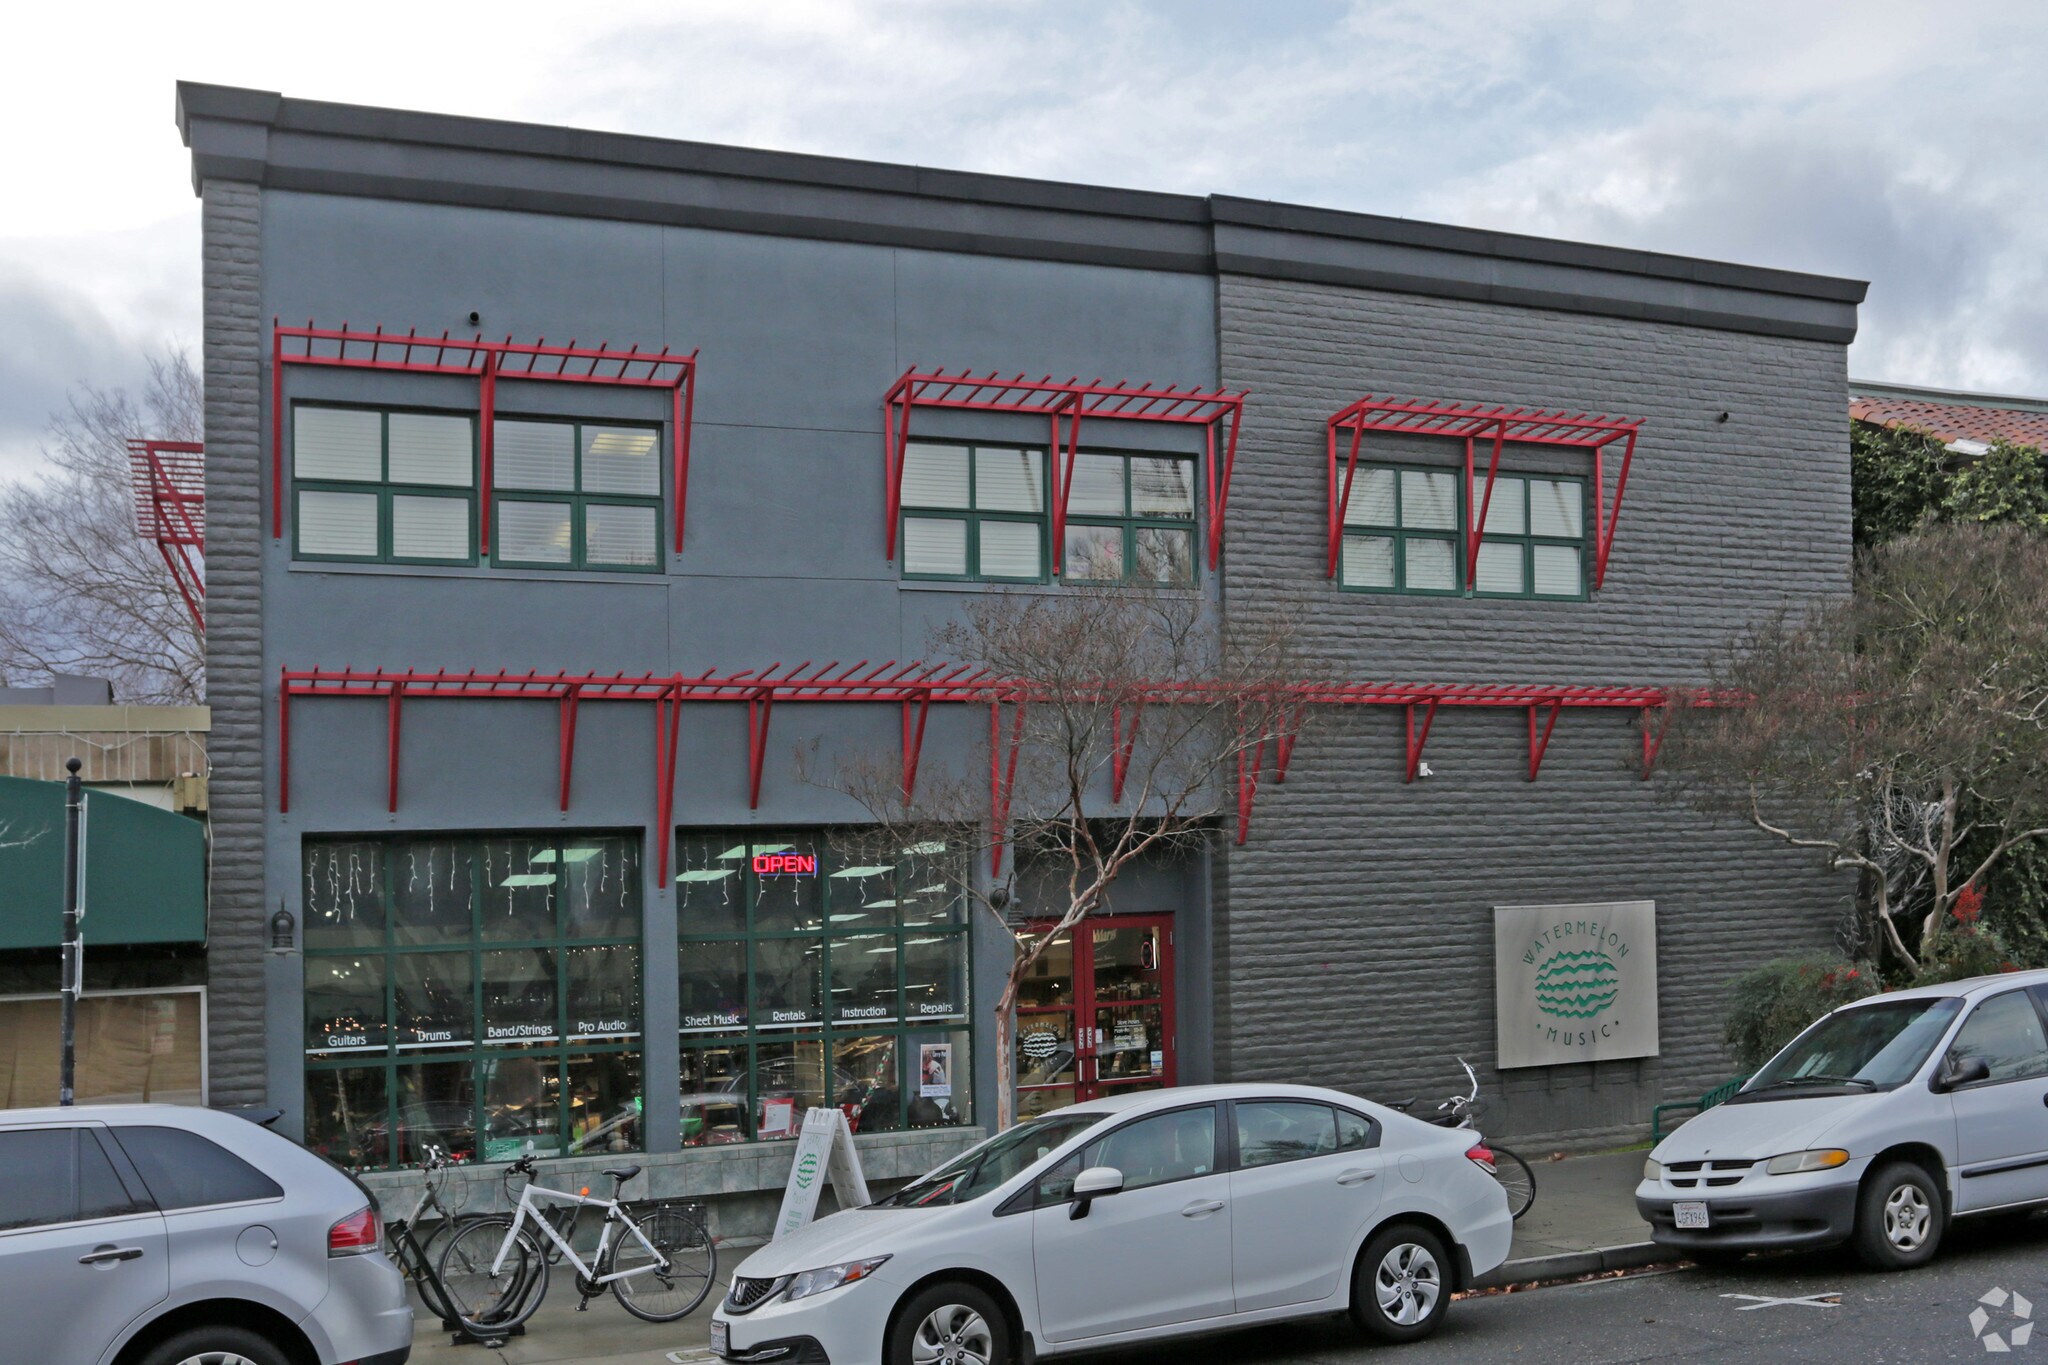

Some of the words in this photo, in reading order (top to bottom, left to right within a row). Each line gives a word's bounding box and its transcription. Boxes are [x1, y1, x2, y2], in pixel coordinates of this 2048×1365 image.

[752, 854, 816, 874] OPEN
[1522, 920, 1631, 966] WATERMELON
[841, 1006, 887, 1018] Instruction
[920, 1003, 953, 1014] Repairs
[685, 1014, 711, 1027] Sheet
[713, 1013, 740, 1025] Music
[772, 1010, 806, 1022] Rentals
[487, 1024, 553, 1039] Band/Strings
[577, 1021, 595, 1033] Pro
[597, 1020, 627, 1032] Audio
[327, 1035, 367, 1048] Guitars
[417, 1029, 452, 1042] Drums
[1546, 1024, 1612, 1046] MUSIC
